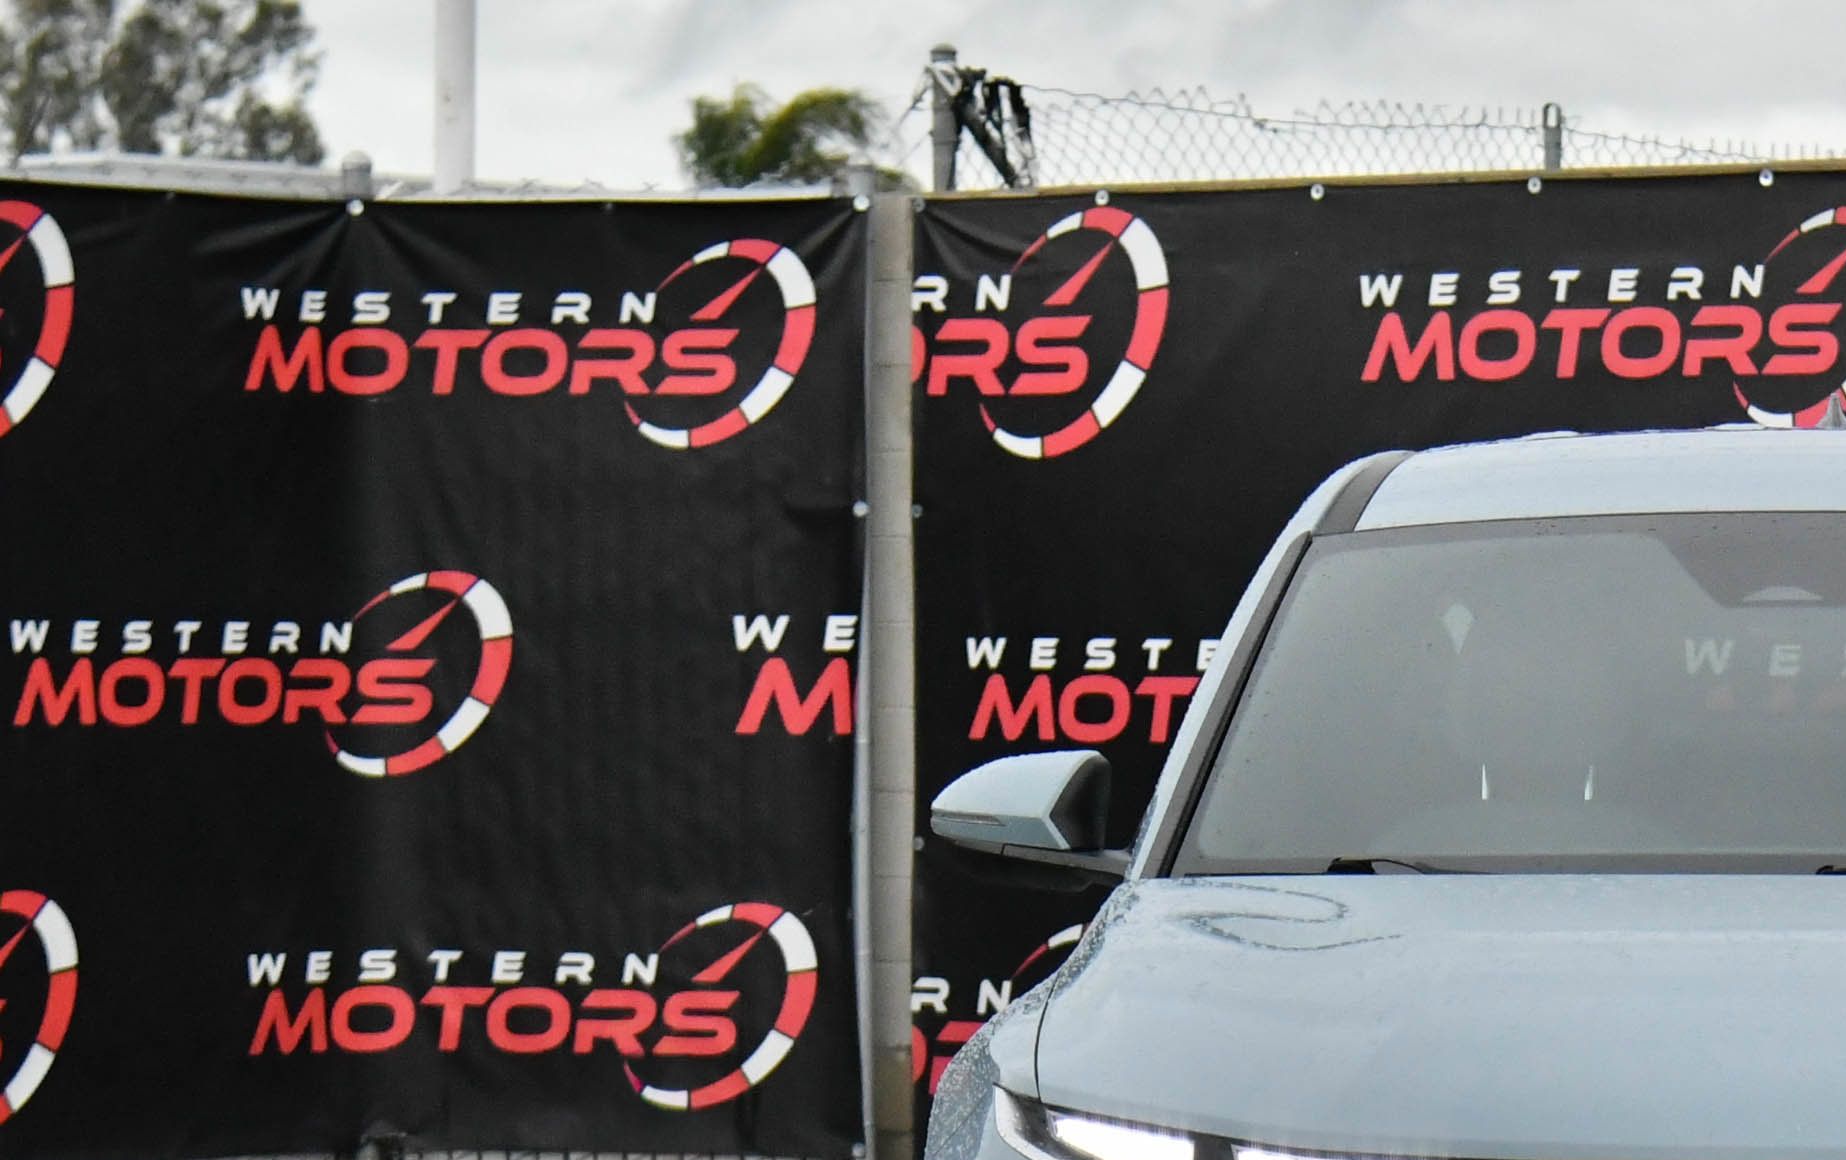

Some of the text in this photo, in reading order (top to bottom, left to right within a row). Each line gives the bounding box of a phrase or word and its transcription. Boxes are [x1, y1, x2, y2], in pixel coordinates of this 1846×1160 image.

[242, 288, 657, 323] WESTERN
[1359, 264, 1766, 307] WESTERN
[245, 325, 740, 396] MOTORS
[1361, 303, 1842, 382] MOTORS
[11, 620, 353, 652] WESTERN
[967, 637, 1222, 671] WESTE
[14, 657, 436, 726] MOTORS
[968, 674, 1200, 743] MOT
[249, 949, 660, 985] WESTERN
[249, 985, 740, 1056] MOTORS
